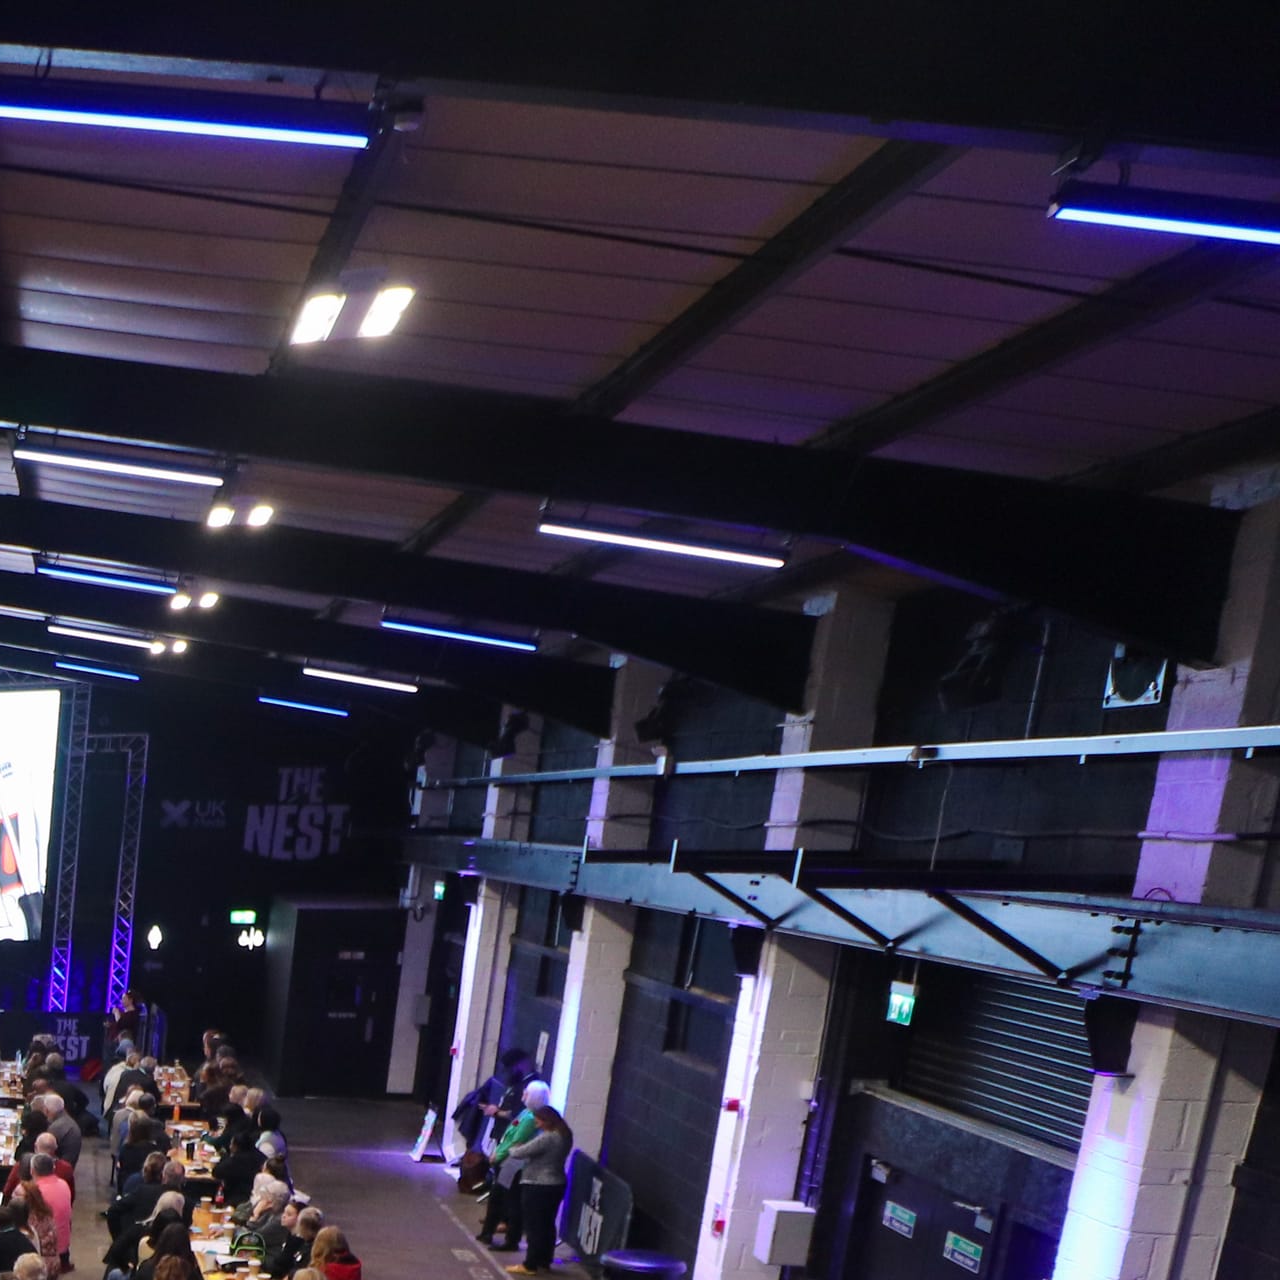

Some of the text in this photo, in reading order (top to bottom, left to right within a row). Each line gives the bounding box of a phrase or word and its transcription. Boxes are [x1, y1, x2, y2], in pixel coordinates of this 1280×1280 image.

[278, 767, 327, 803] THE
[243, 804, 350, 860] NEST
[56, 1019, 79, 1035] THE
[54, 1036, 90, 1061] EST
